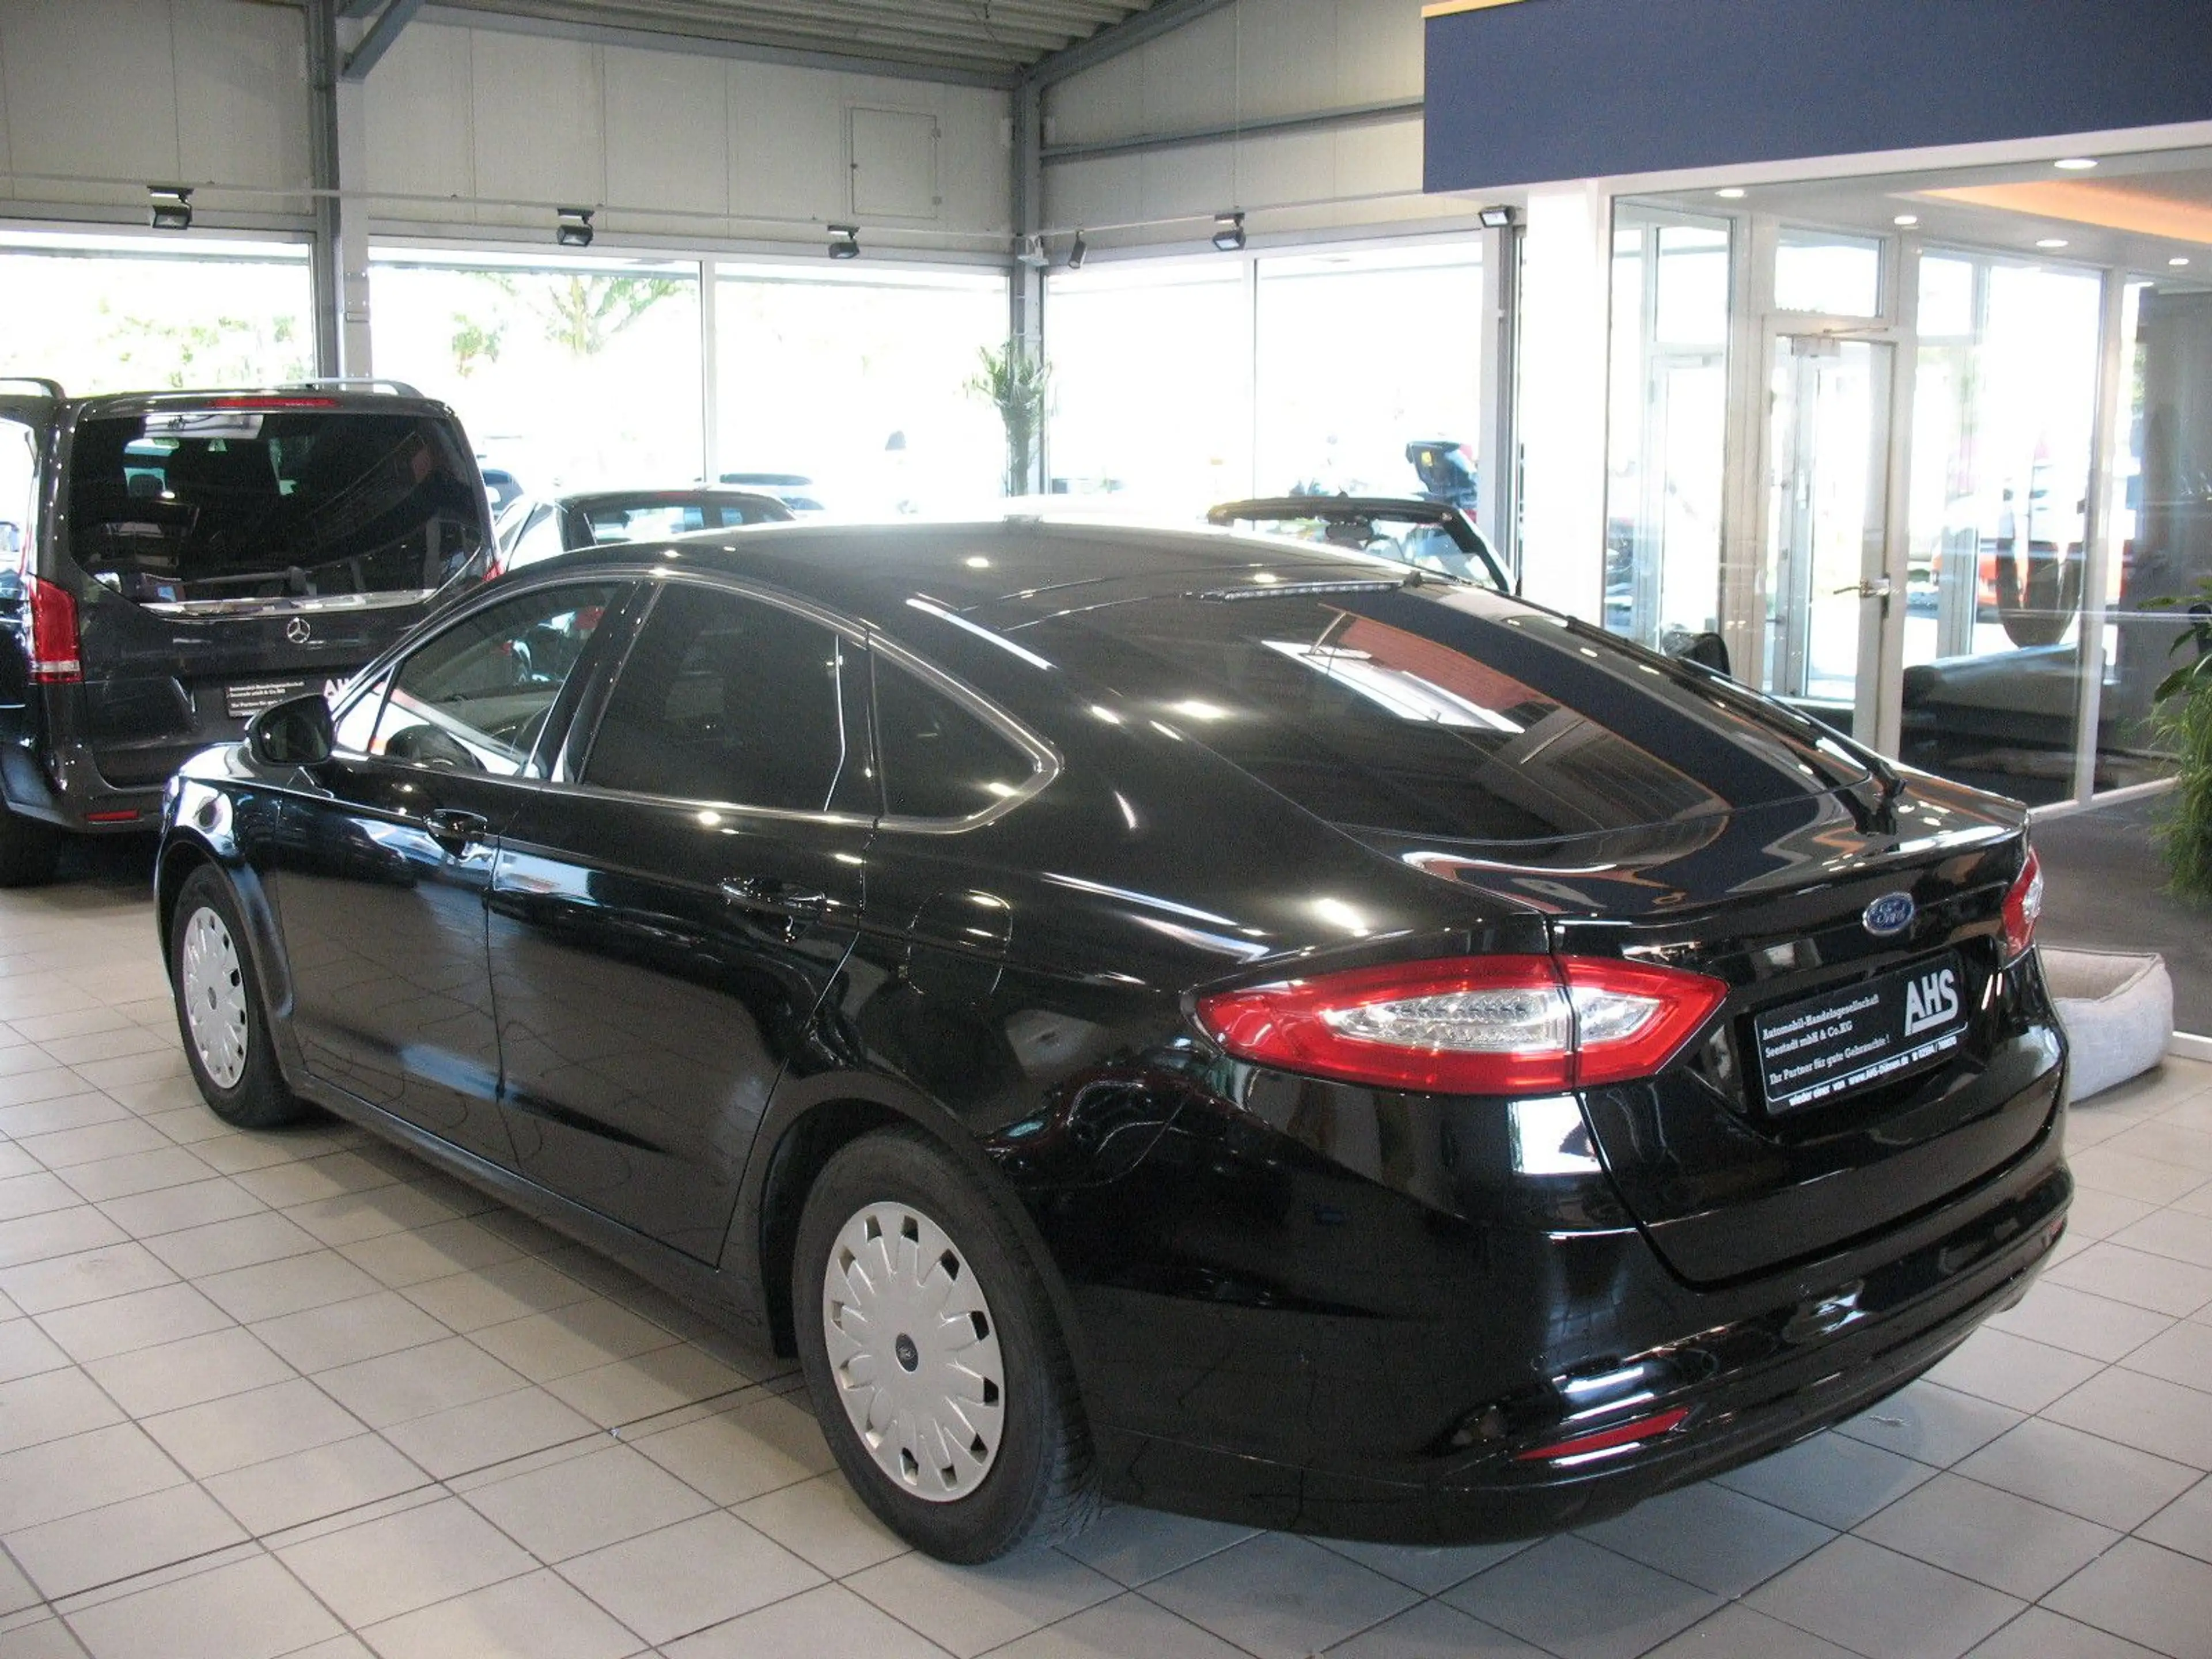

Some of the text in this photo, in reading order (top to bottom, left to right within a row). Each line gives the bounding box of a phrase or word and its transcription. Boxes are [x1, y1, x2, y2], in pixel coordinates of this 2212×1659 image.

[1904, 969, 1959, 1037] AHS
[1769, 1073, 1782, 1085] Ihr
[1783, 1062, 1813, 1081] Partner
[1813, 1058, 1826, 1070] für
[1826, 1052, 1844, 1068] gute
